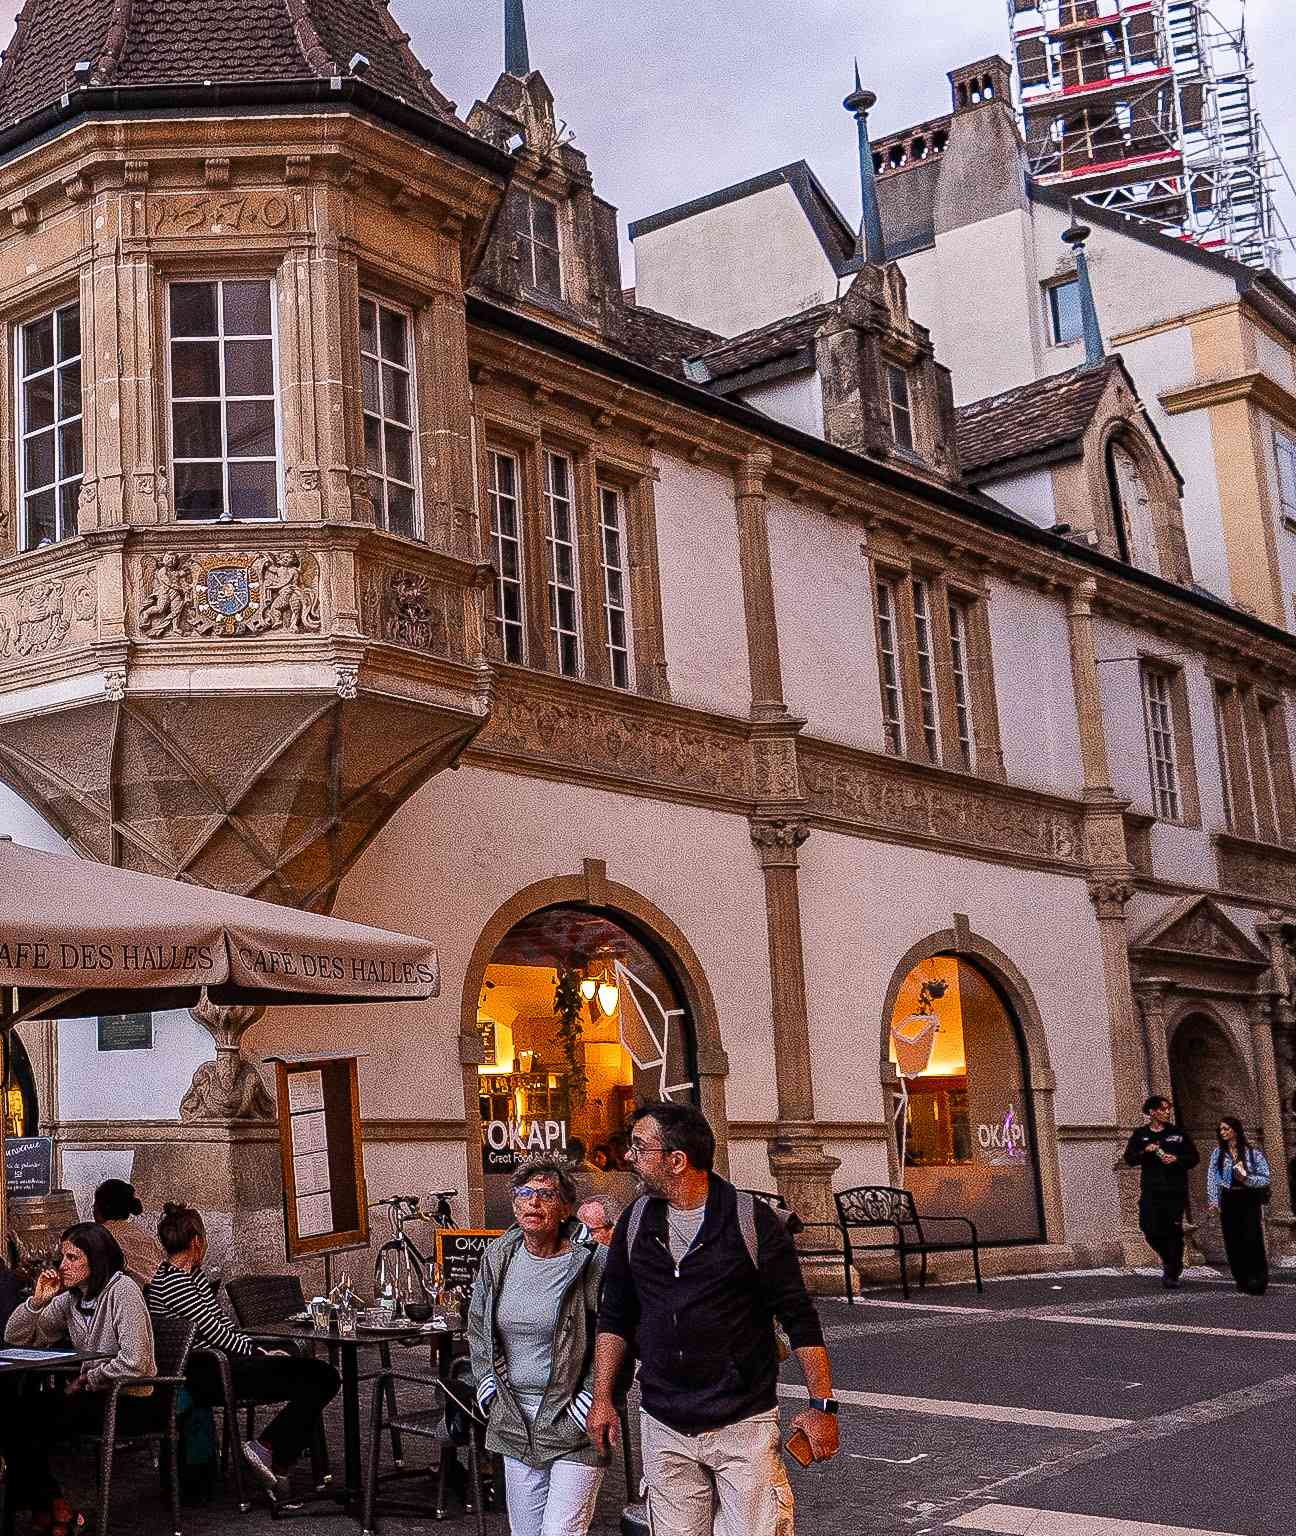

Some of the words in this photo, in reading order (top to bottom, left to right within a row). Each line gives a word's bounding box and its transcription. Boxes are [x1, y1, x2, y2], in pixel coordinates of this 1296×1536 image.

[61, 943, 113, 970] DES
[122, 944, 214, 971] HALLES
[239, 945, 296, 976] CAFÉ
[300, 953, 345, 980] DES
[351, 959, 435, 984] HALLES
[487, 1120, 567, 1150] OKAPI
[455, 1237, 496, 1251] OKAP
